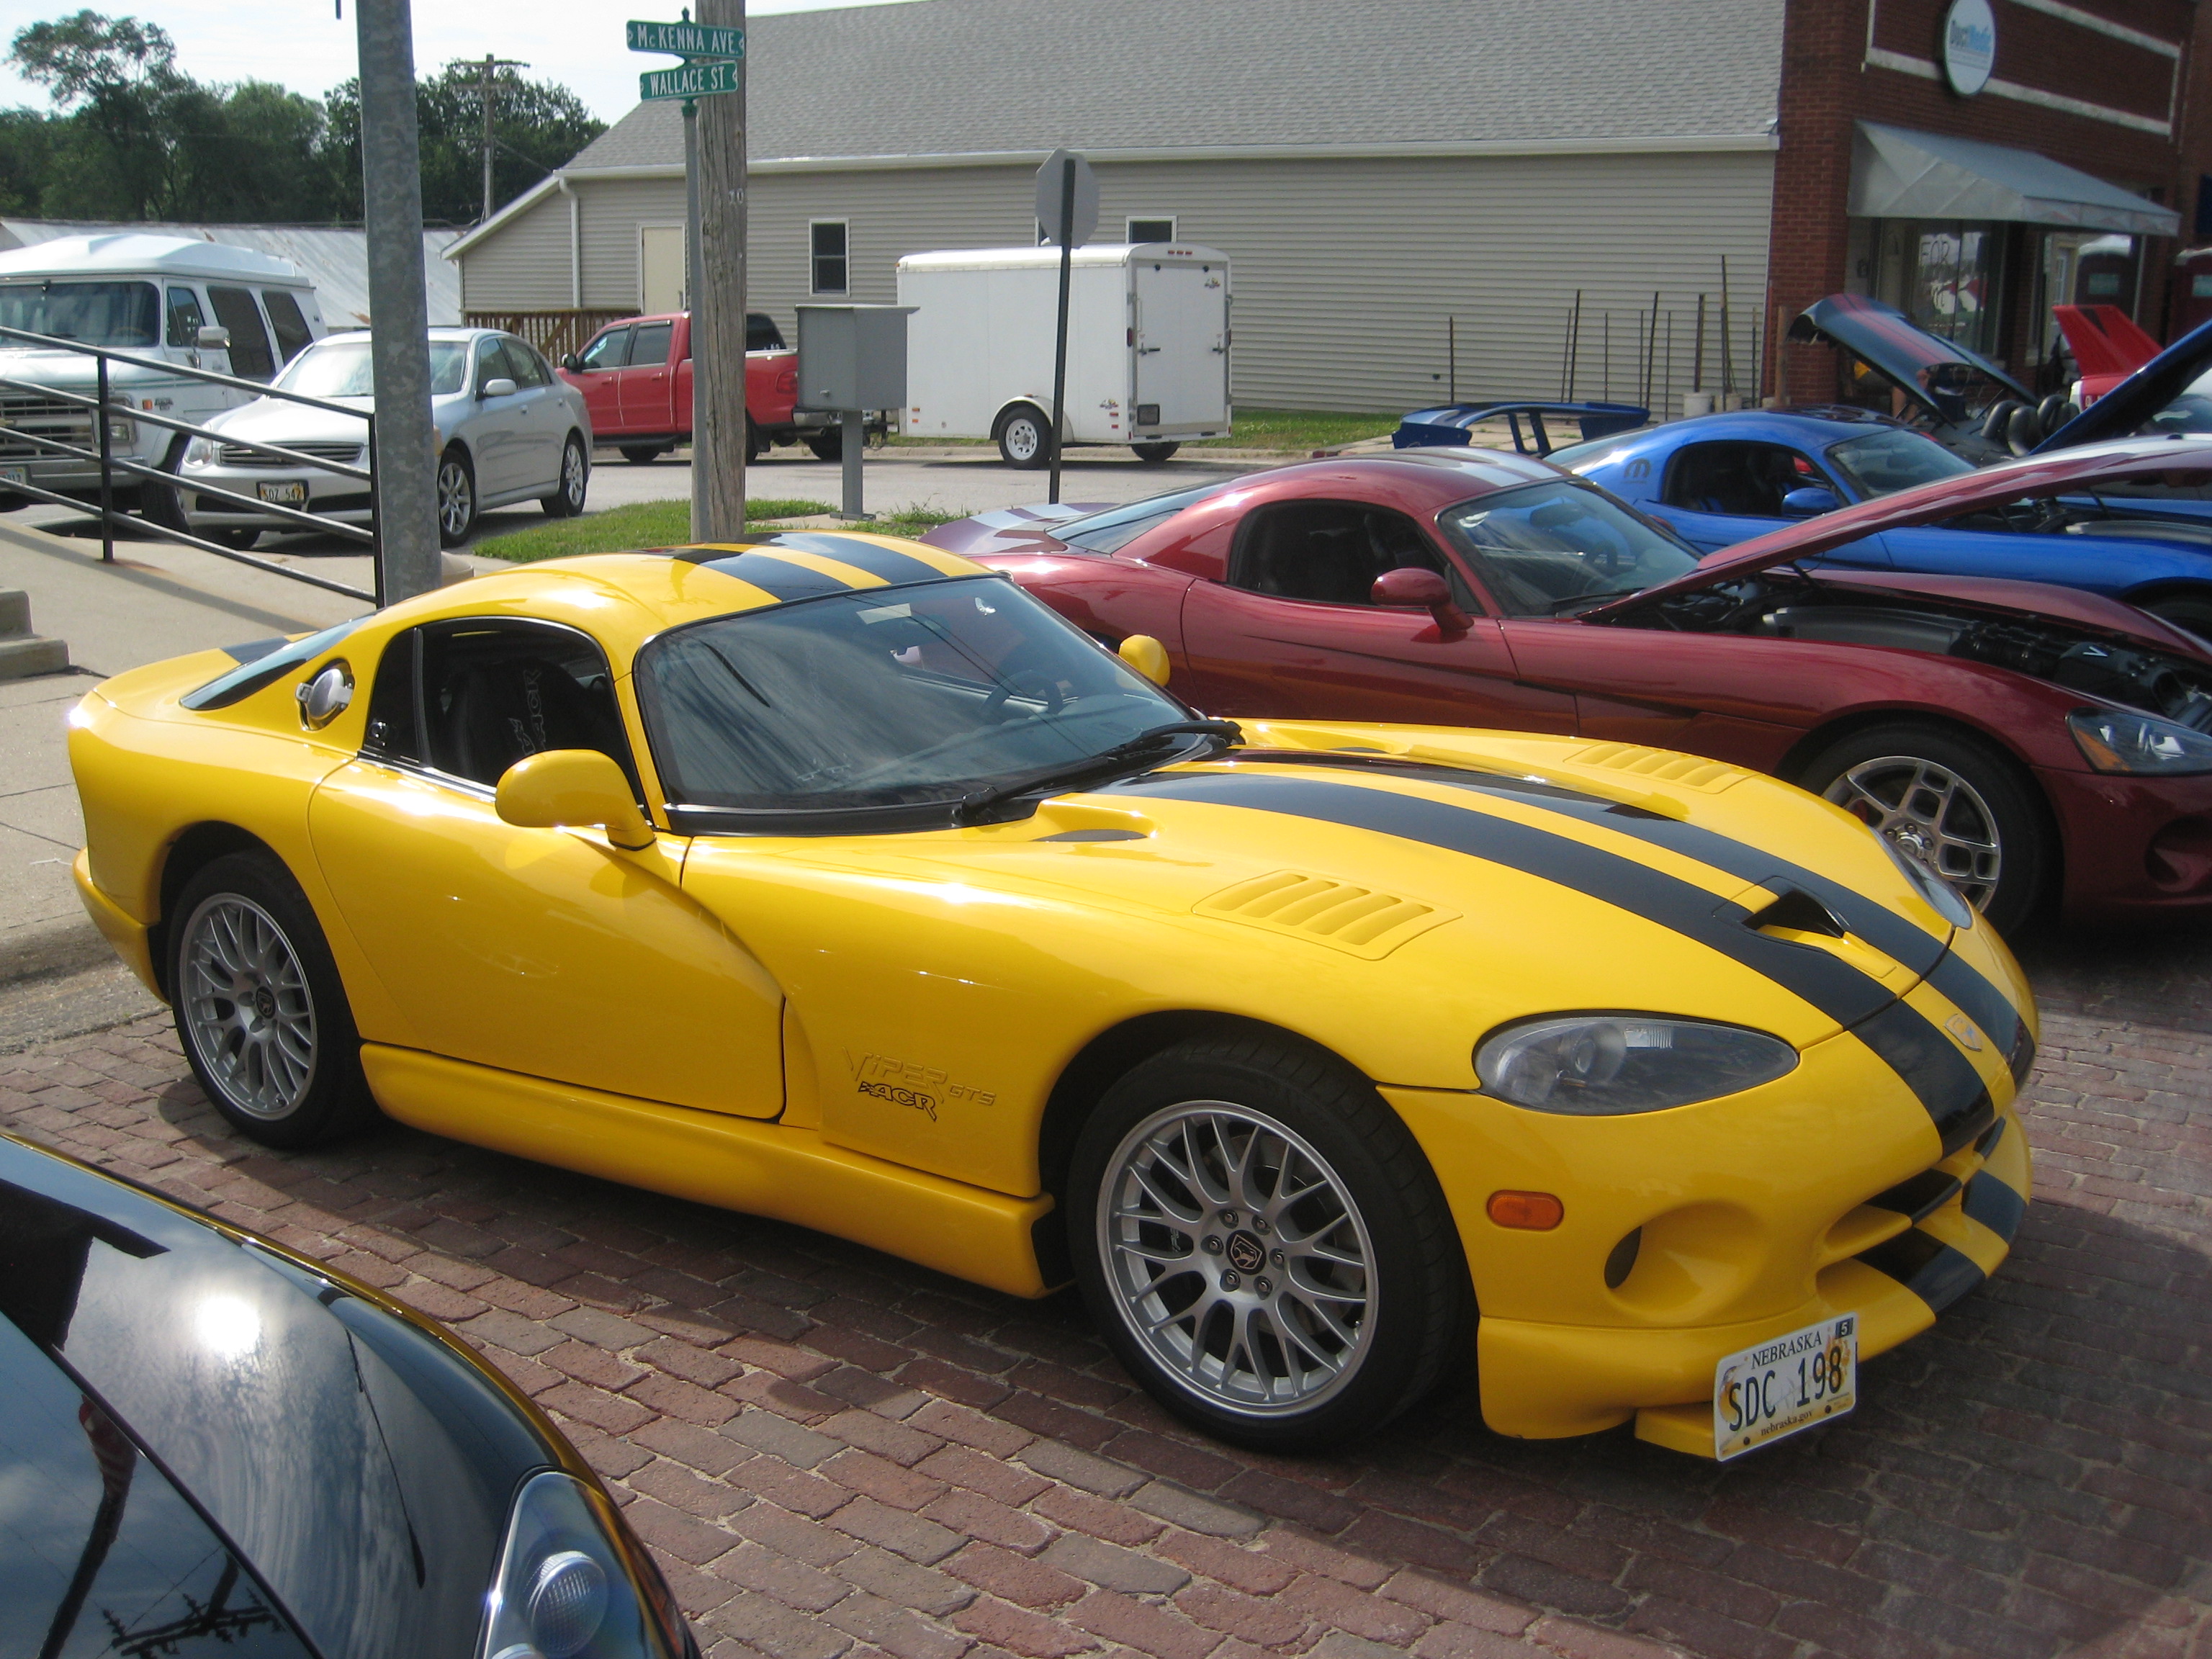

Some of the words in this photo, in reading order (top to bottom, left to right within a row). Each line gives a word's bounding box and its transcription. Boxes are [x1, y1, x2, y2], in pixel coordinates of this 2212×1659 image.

[637, 24, 705, 51] McKENNA
[650, 68, 705, 96] WALLACE
[711, 66, 725, 90] ST
[860, 1082, 938, 1122] ACR
[949, 1082, 997, 1107] GTS
[1751, 1331, 1822, 1370] NEBRASKA
[1729, 1370, 1776, 1431] SDC
[1796, 1345, 1842, 1408] 198
